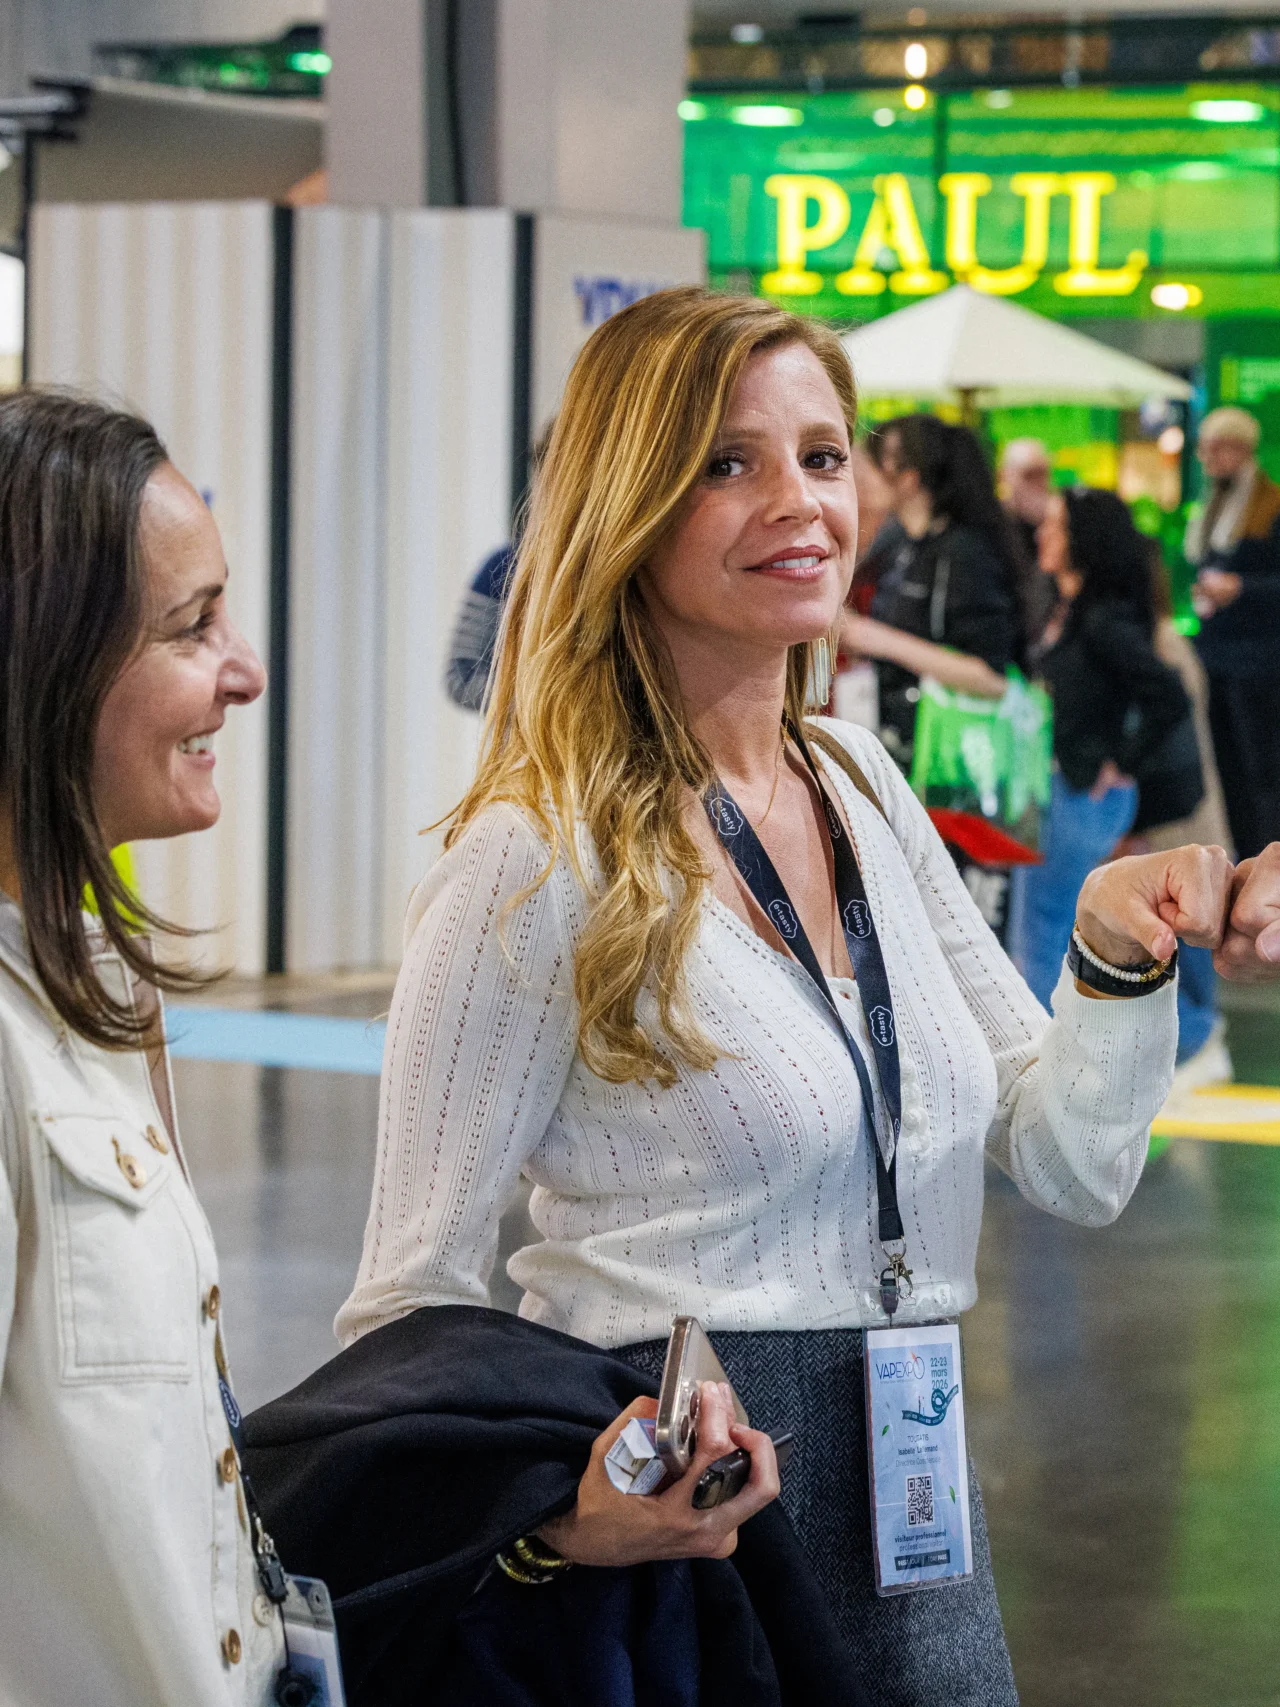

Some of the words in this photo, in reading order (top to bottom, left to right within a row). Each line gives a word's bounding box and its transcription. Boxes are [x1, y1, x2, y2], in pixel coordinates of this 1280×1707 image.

[762, 172, 1149, 296] PAUL
[876, 1356, 925, 1380] VAPEXPO
[931, 1368, 948, 1377] mars
[931, 1379, 949, 1390] 2026
